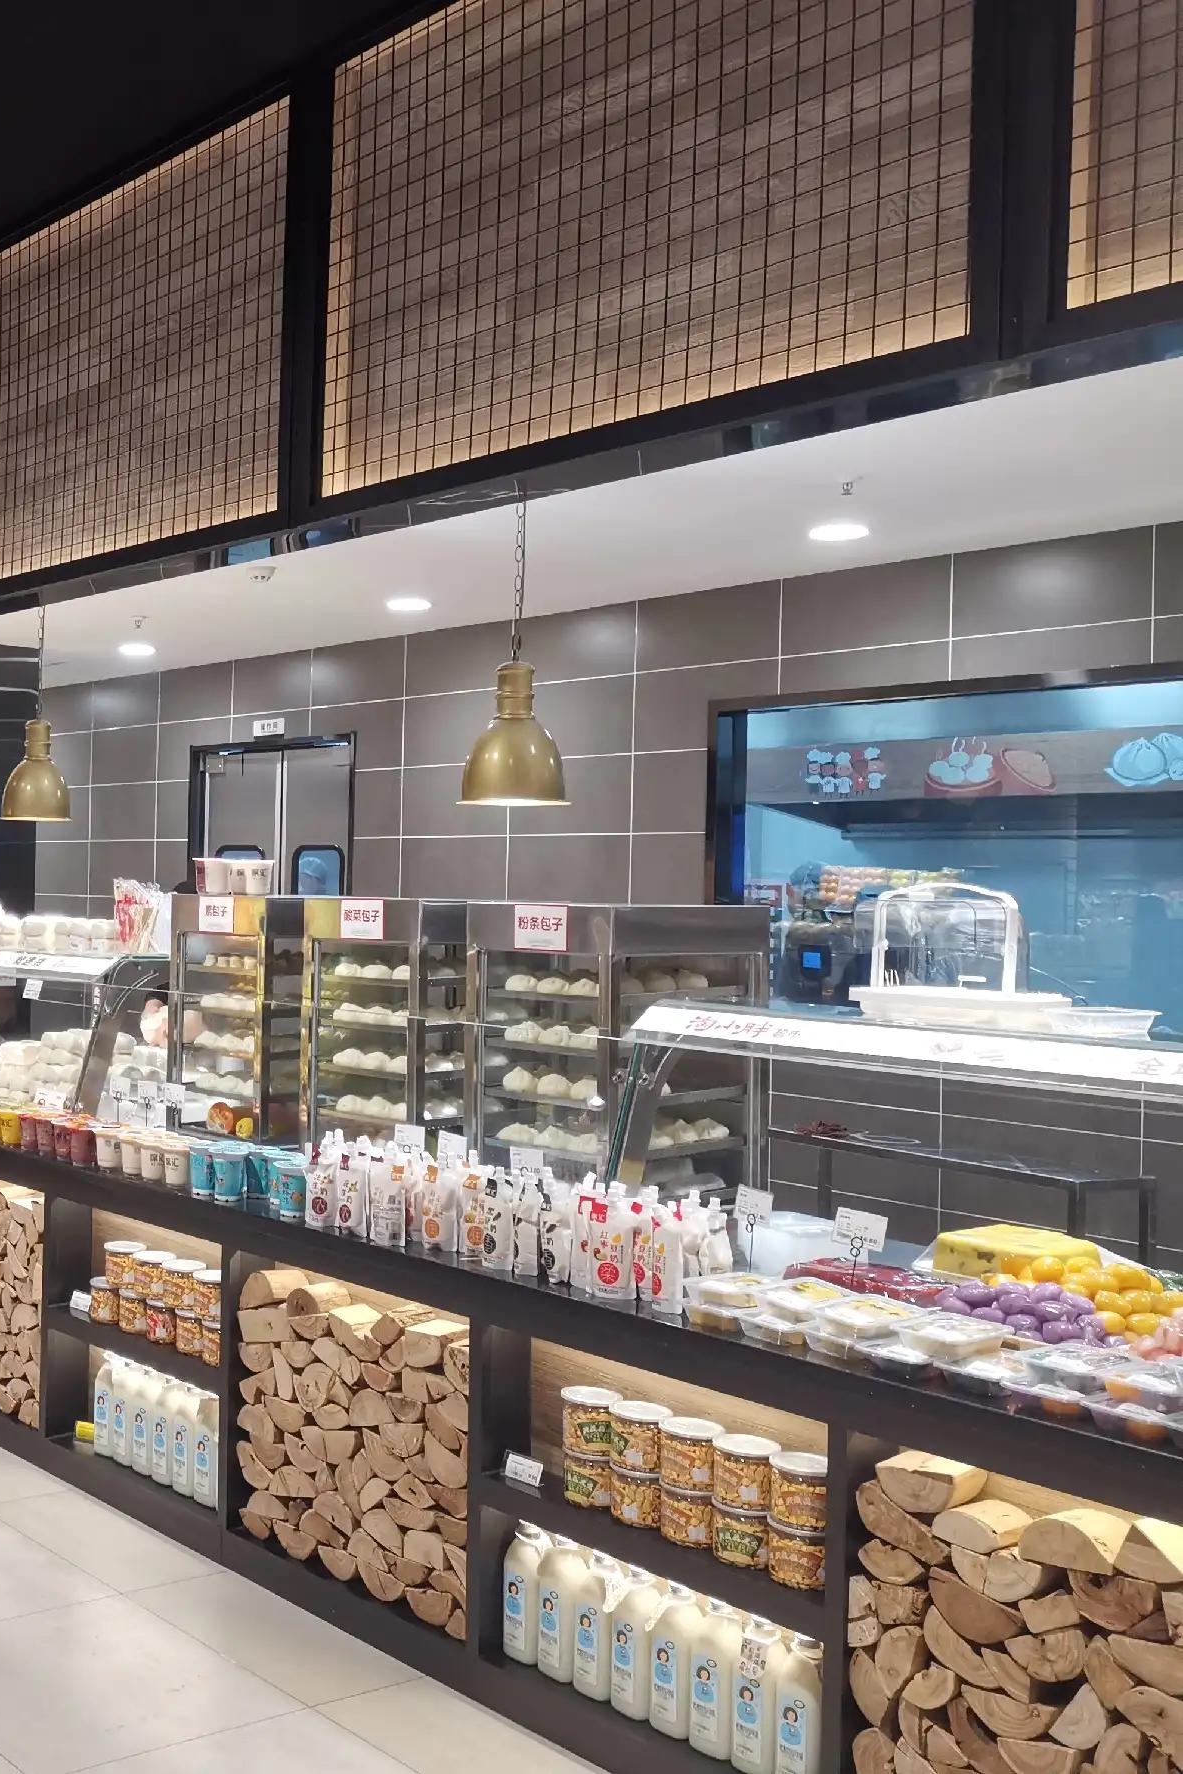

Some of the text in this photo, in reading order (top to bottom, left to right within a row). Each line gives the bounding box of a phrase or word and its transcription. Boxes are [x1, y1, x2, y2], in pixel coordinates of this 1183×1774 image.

[343, 909, 380, 923] 酸菜包子
[518, 916, 563, 931] 粉条包子
